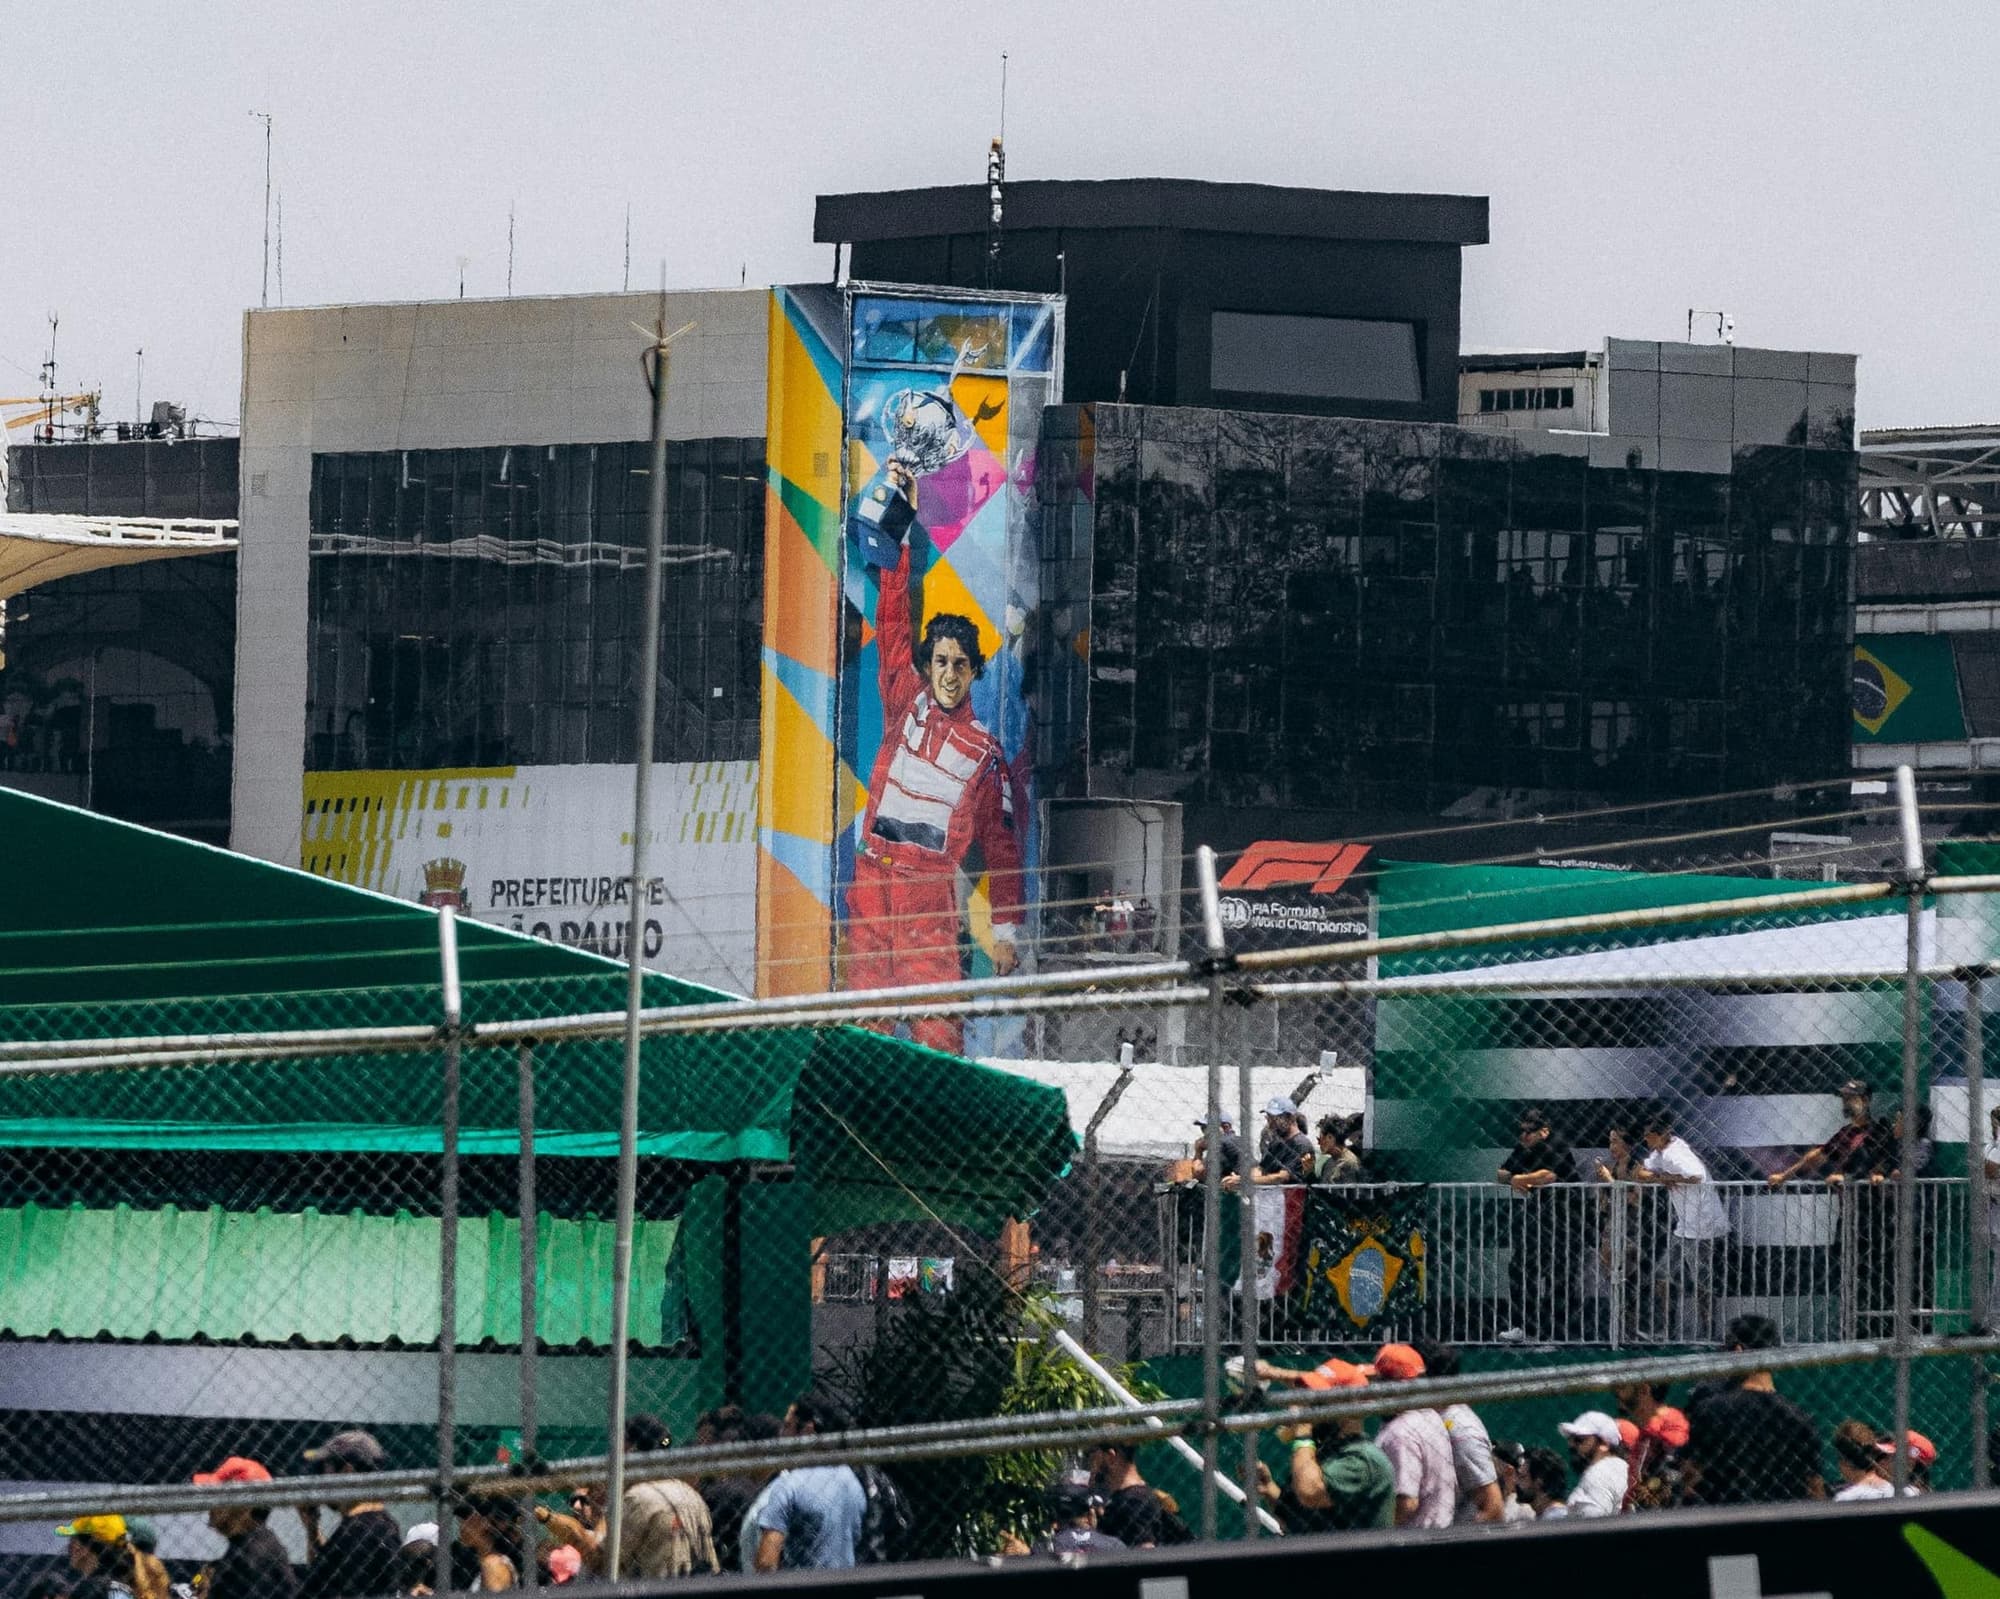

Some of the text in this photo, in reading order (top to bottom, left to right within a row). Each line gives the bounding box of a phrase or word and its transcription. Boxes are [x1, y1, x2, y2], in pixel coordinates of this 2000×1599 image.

[490, 876, 628, 907] PREFEITURA
[1252, 902, 1270, 914] FIA
[1271, 903, 1317, 918] Formula
[1252, 916, 1368, 935] World Championship
